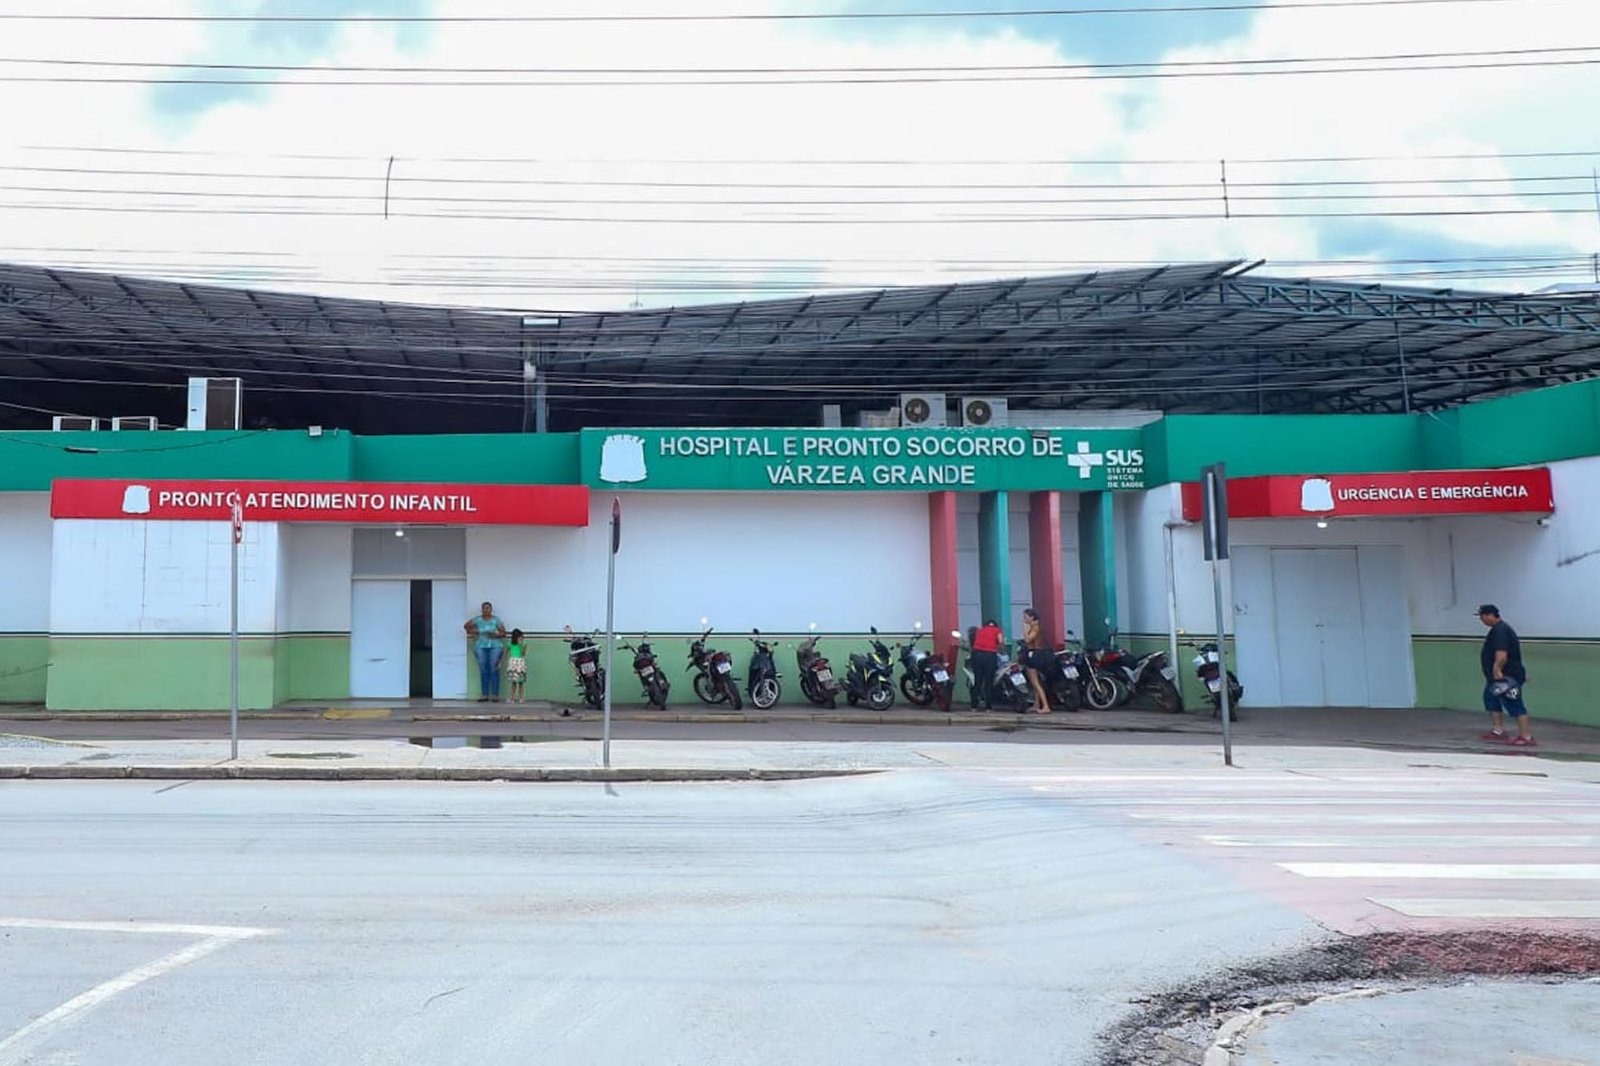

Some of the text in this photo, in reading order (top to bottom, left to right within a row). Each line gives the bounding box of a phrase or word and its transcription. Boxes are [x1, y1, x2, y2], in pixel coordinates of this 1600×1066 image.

[660, 437, 1063, 456] HOSPITAL E PRONTO SOCORRO DE
[1105, 449, 1144, 466] SUS
[767, 459, 975, 484] VÁRZEA GRANDE
[1338, 482, 1528, 500] URGÊNCIA E EMERGÊNCIA
[245, 493, 385, 510] ATENDIMENTO
[390, 495, 477, 512] INFANTIL
